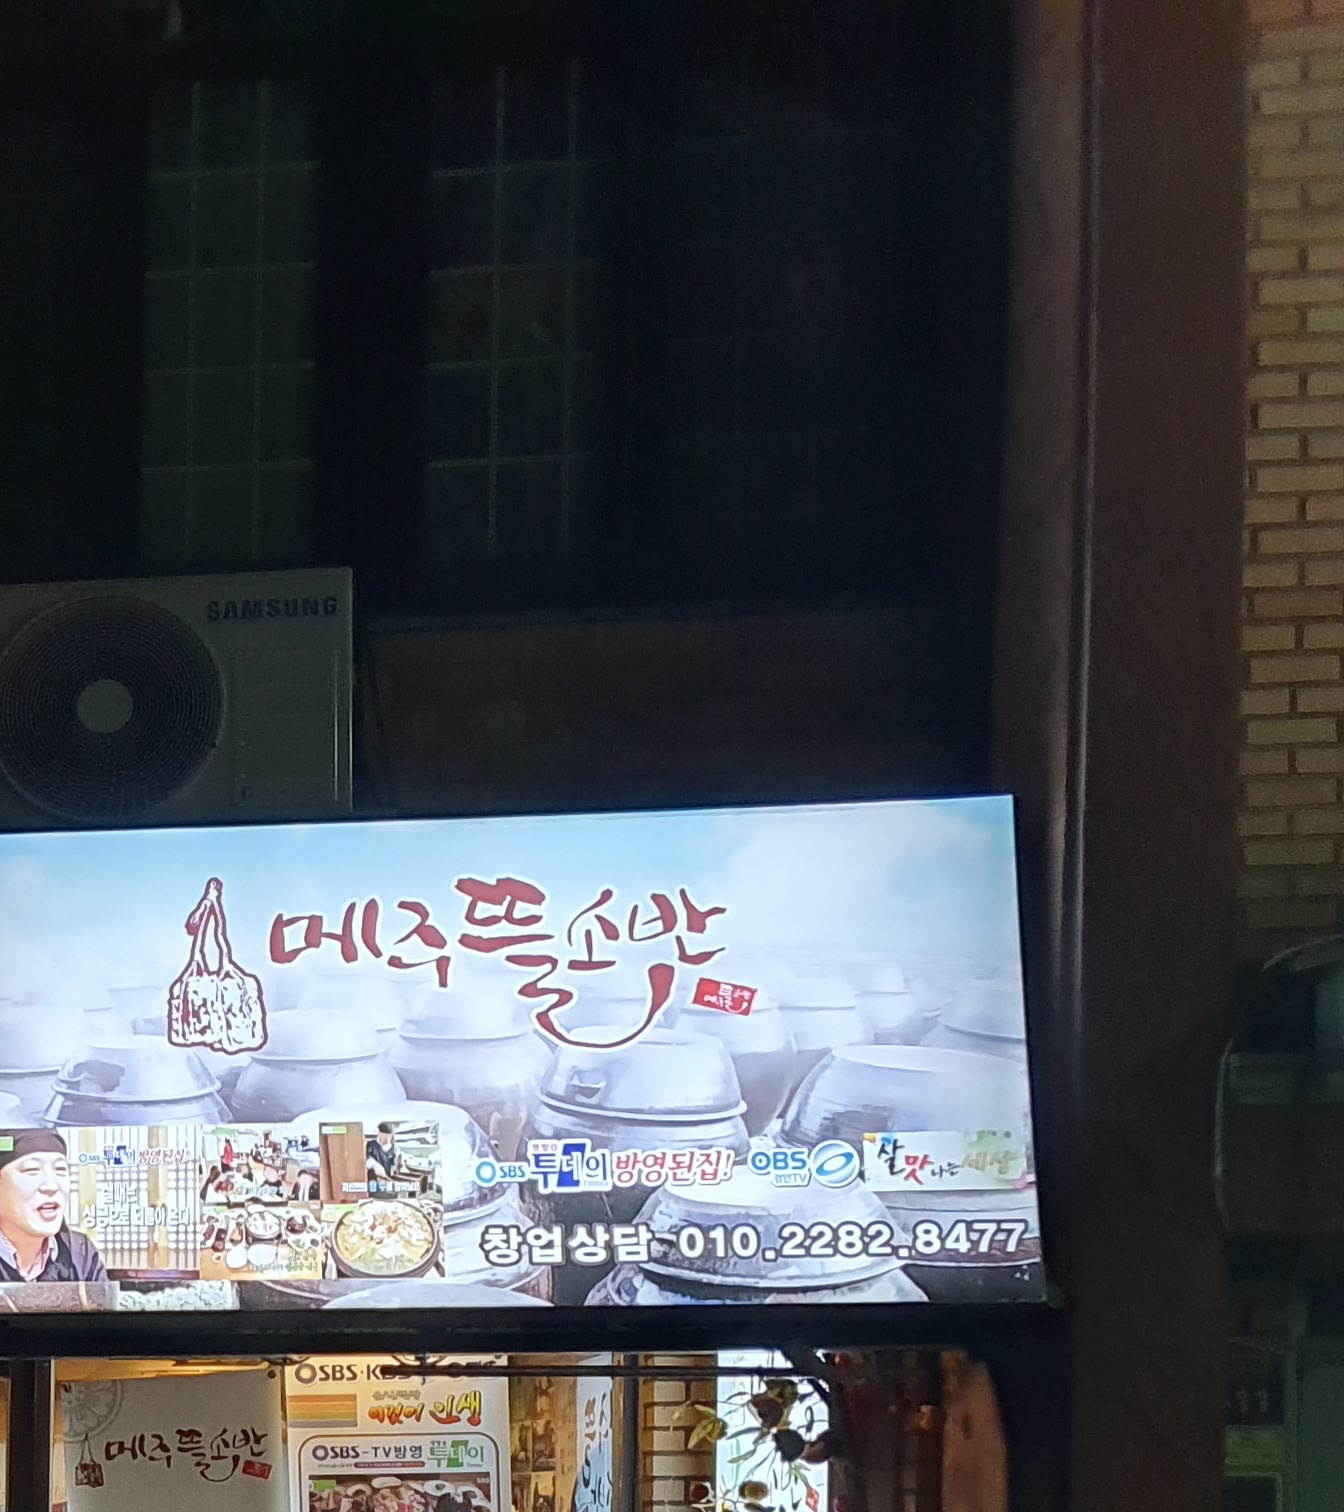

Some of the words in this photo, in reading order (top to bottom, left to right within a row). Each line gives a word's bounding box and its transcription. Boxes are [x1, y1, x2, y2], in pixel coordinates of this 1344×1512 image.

[206, 596, 337, 621] SAMSUNG
[269, 877, 727, 1049] 메주뜰소반
[499, 1165, 526, 1179] SBS
[750, 1151, 807, 1171] OBS
[482, 1225, 653, 1265] 창업상담
[678, 1221, 1026, 1259] 010.2282.8477
[429, 1390, 482, 1426] 인생
[105, 1426, 268, 1482] 메주뜰소반
